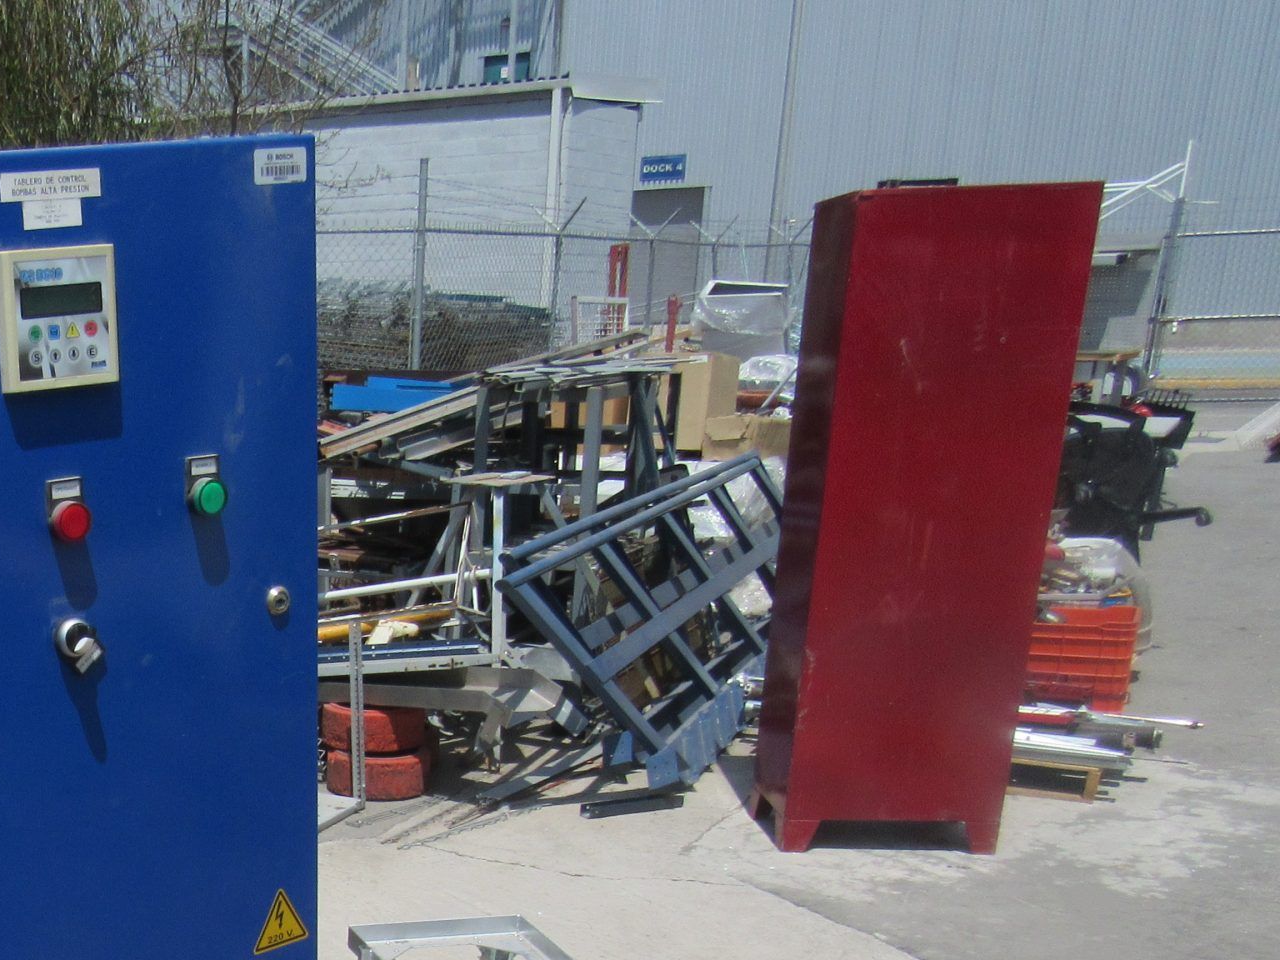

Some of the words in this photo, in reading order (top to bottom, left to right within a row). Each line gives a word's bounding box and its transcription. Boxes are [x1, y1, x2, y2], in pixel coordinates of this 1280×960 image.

[643, 164, 672, 173] DOCK
[13, 178, 42, 187] TABLERO
[45, 177, 55, 185] DE
[58, 175, 87, 184] CONTROL
[11, 189, 37, 197] BOMBAS
[40, 187, 58, 195] ALTA
[61, 186, 90, 194] PRESION
[267, 933, 284, 944] 220
